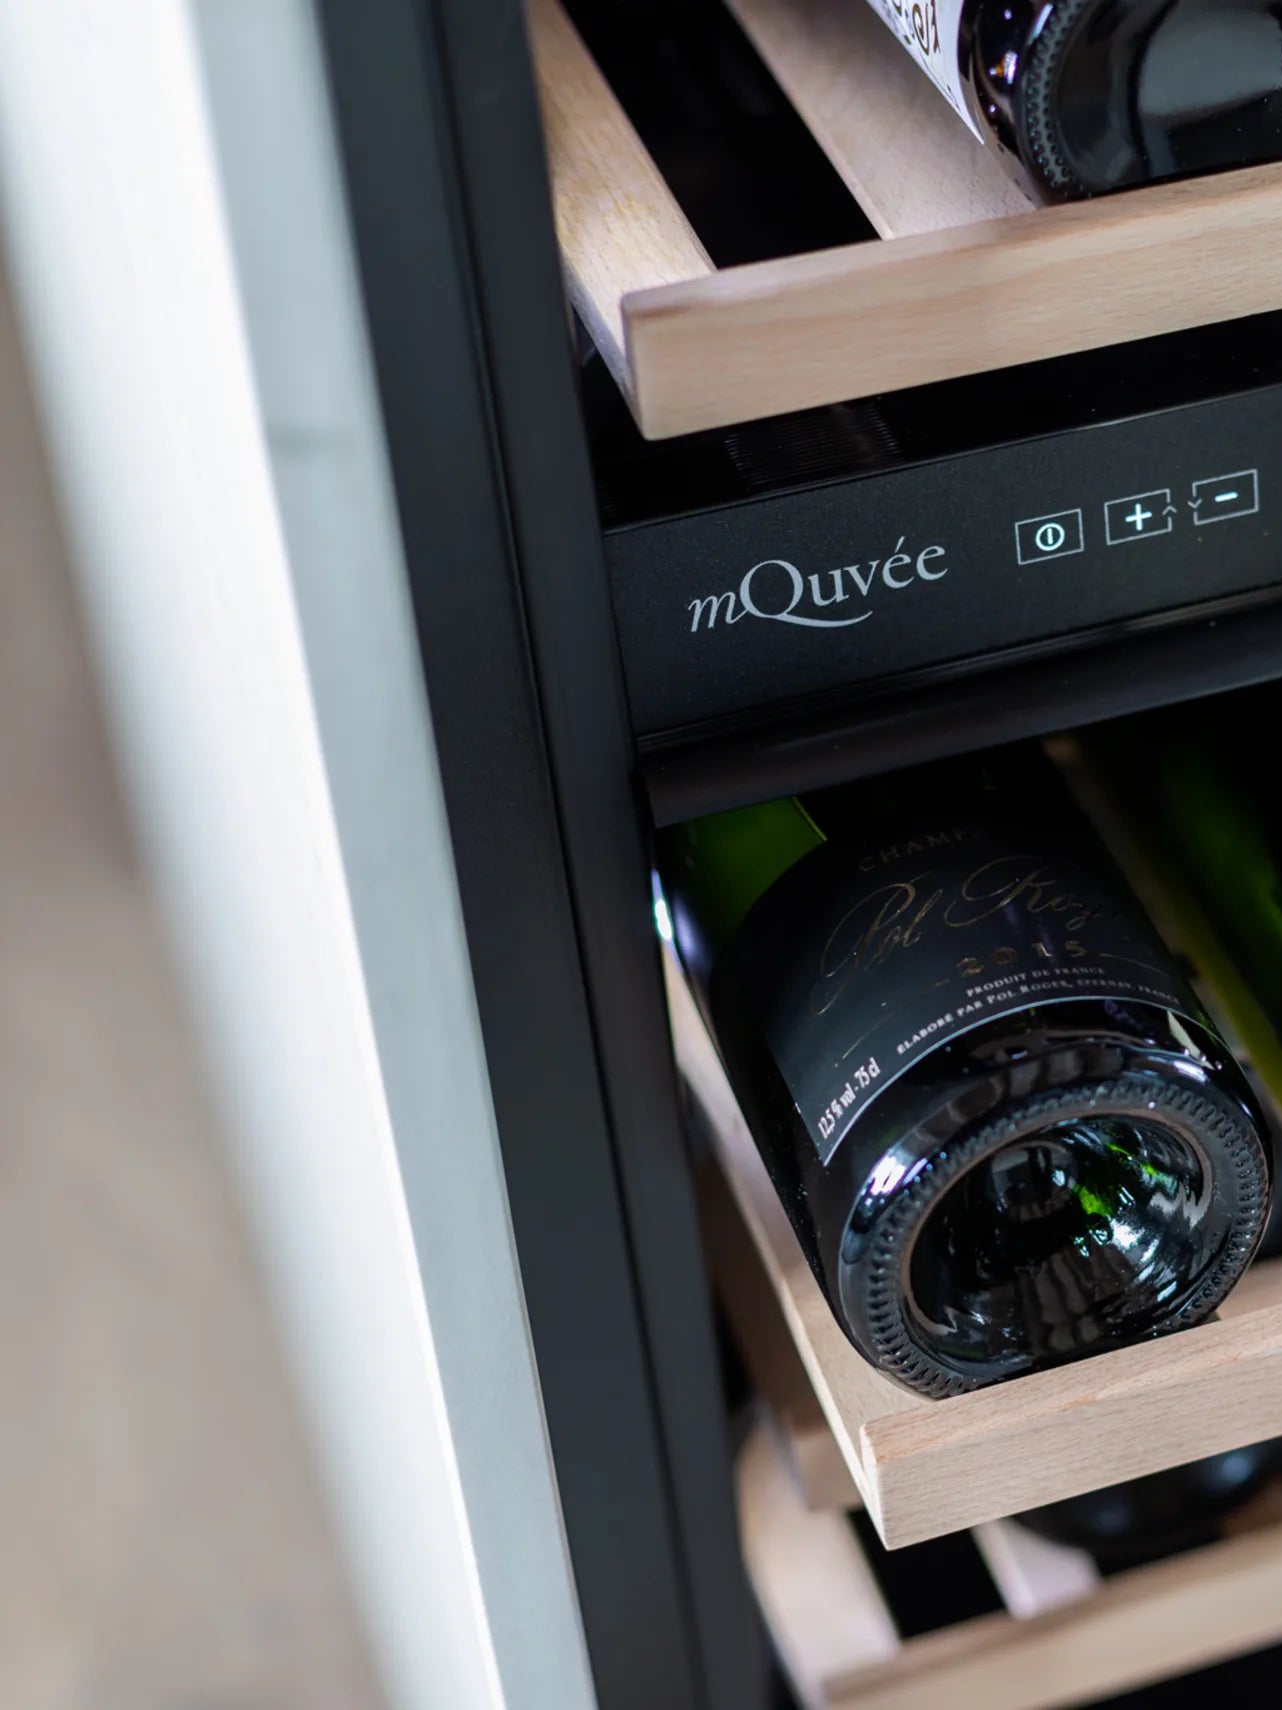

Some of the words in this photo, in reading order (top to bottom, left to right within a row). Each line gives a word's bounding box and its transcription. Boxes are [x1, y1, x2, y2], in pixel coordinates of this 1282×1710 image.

[688, 536, 948, 633] mQuvée
[966, 972, 1028, 998] PRODUIT
[956, 1000, 984, 1018] PAR
